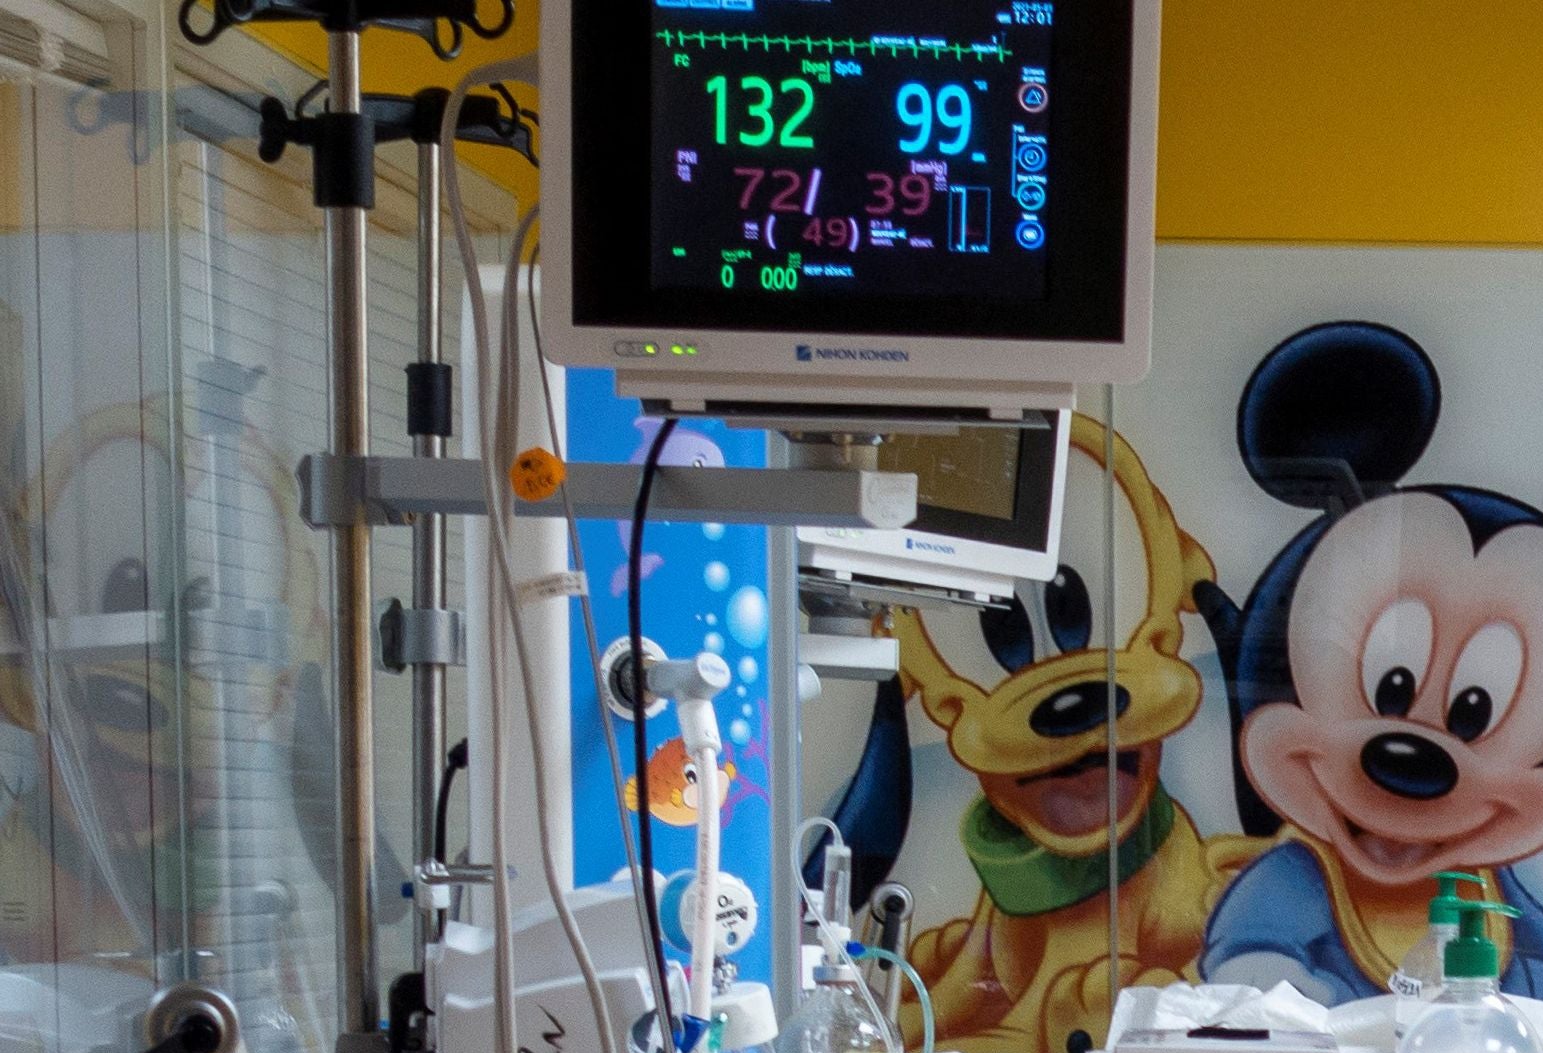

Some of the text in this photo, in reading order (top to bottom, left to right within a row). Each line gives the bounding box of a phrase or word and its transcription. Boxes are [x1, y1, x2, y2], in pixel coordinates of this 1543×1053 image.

[1014, 11, 1052, 25] 12:01
[706, 75, 815, 149] 132
[896, 83, 972, 155] 99
[865, 172, 931, 216] 39
